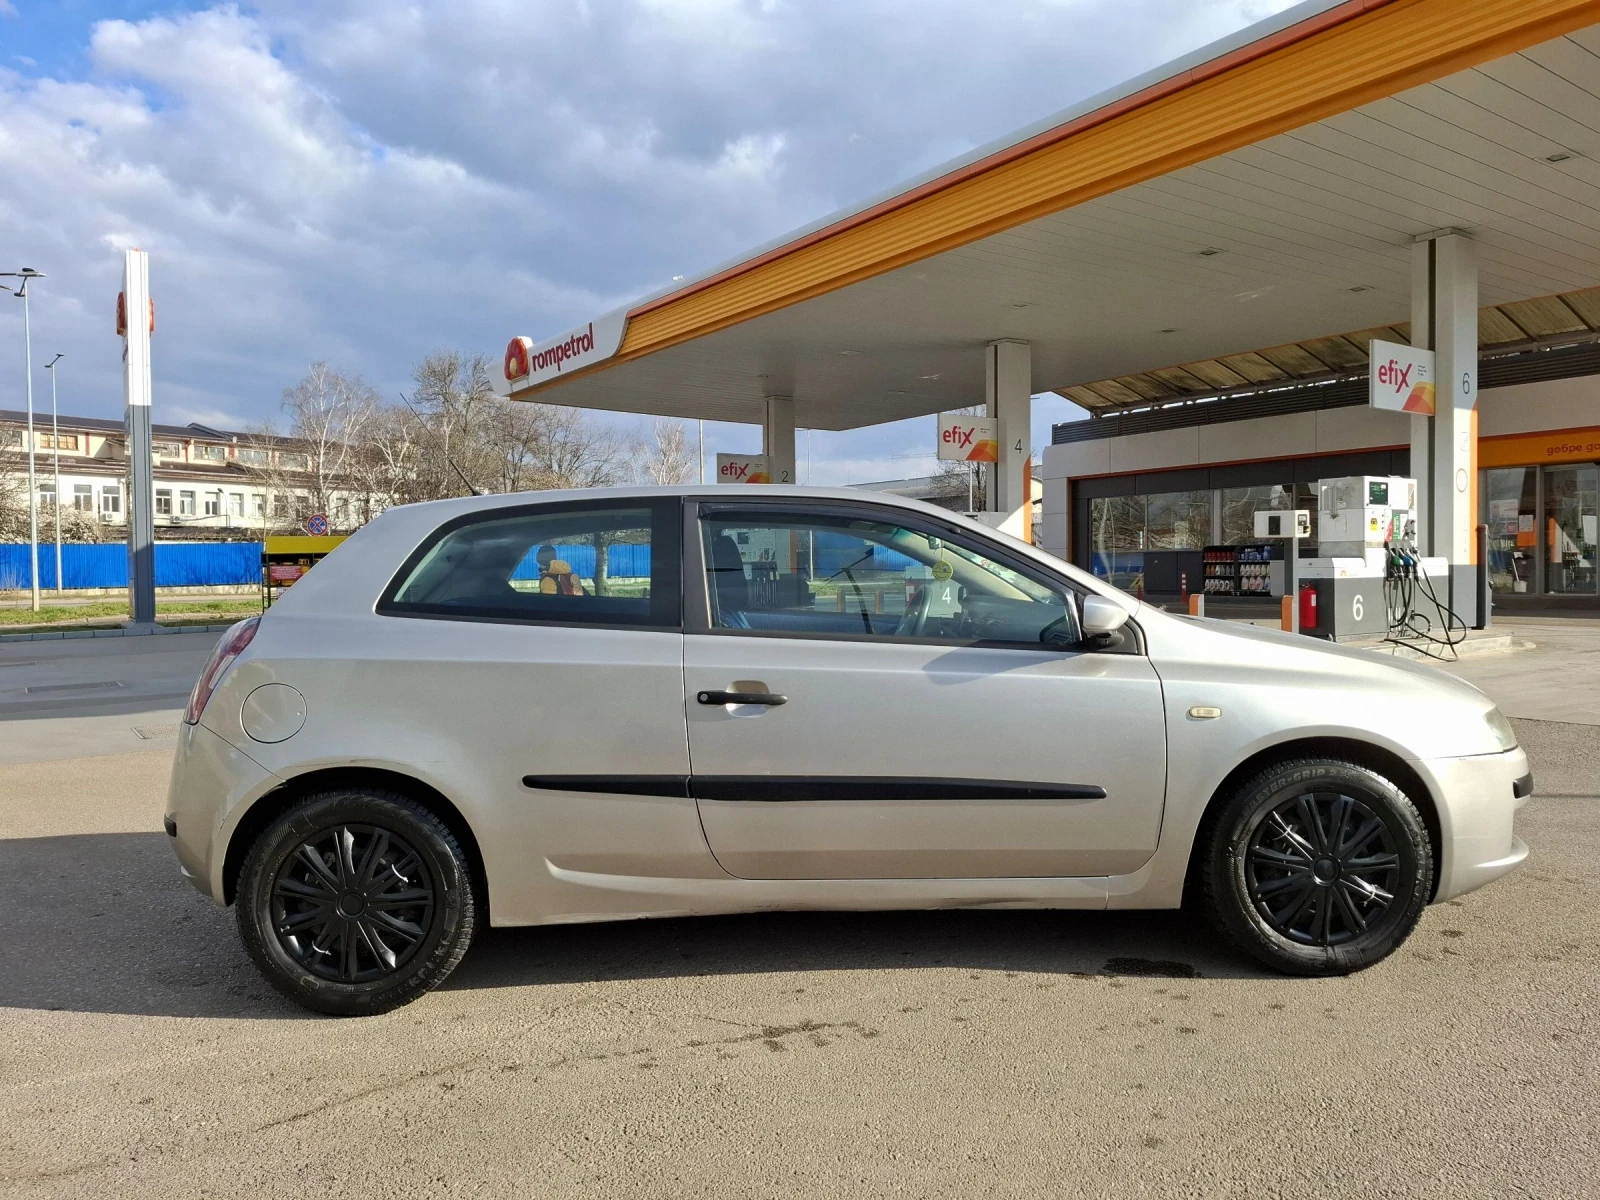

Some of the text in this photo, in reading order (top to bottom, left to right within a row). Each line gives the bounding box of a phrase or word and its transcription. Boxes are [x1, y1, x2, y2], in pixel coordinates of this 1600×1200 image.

[532, 323, 594, 372] rompetrol
[1378, 359, 1413, 393] efix
[1462, 372, 1471, 395] 6
[942, 425, 976, 449] efix
[1014, 438, 1023, 454] 4
[720, 461, 750, 480] efix
[781, 470, 789, 483] 2
[941, 586, 952, 604] 4
[1352, 594, 1364, 621] 6
